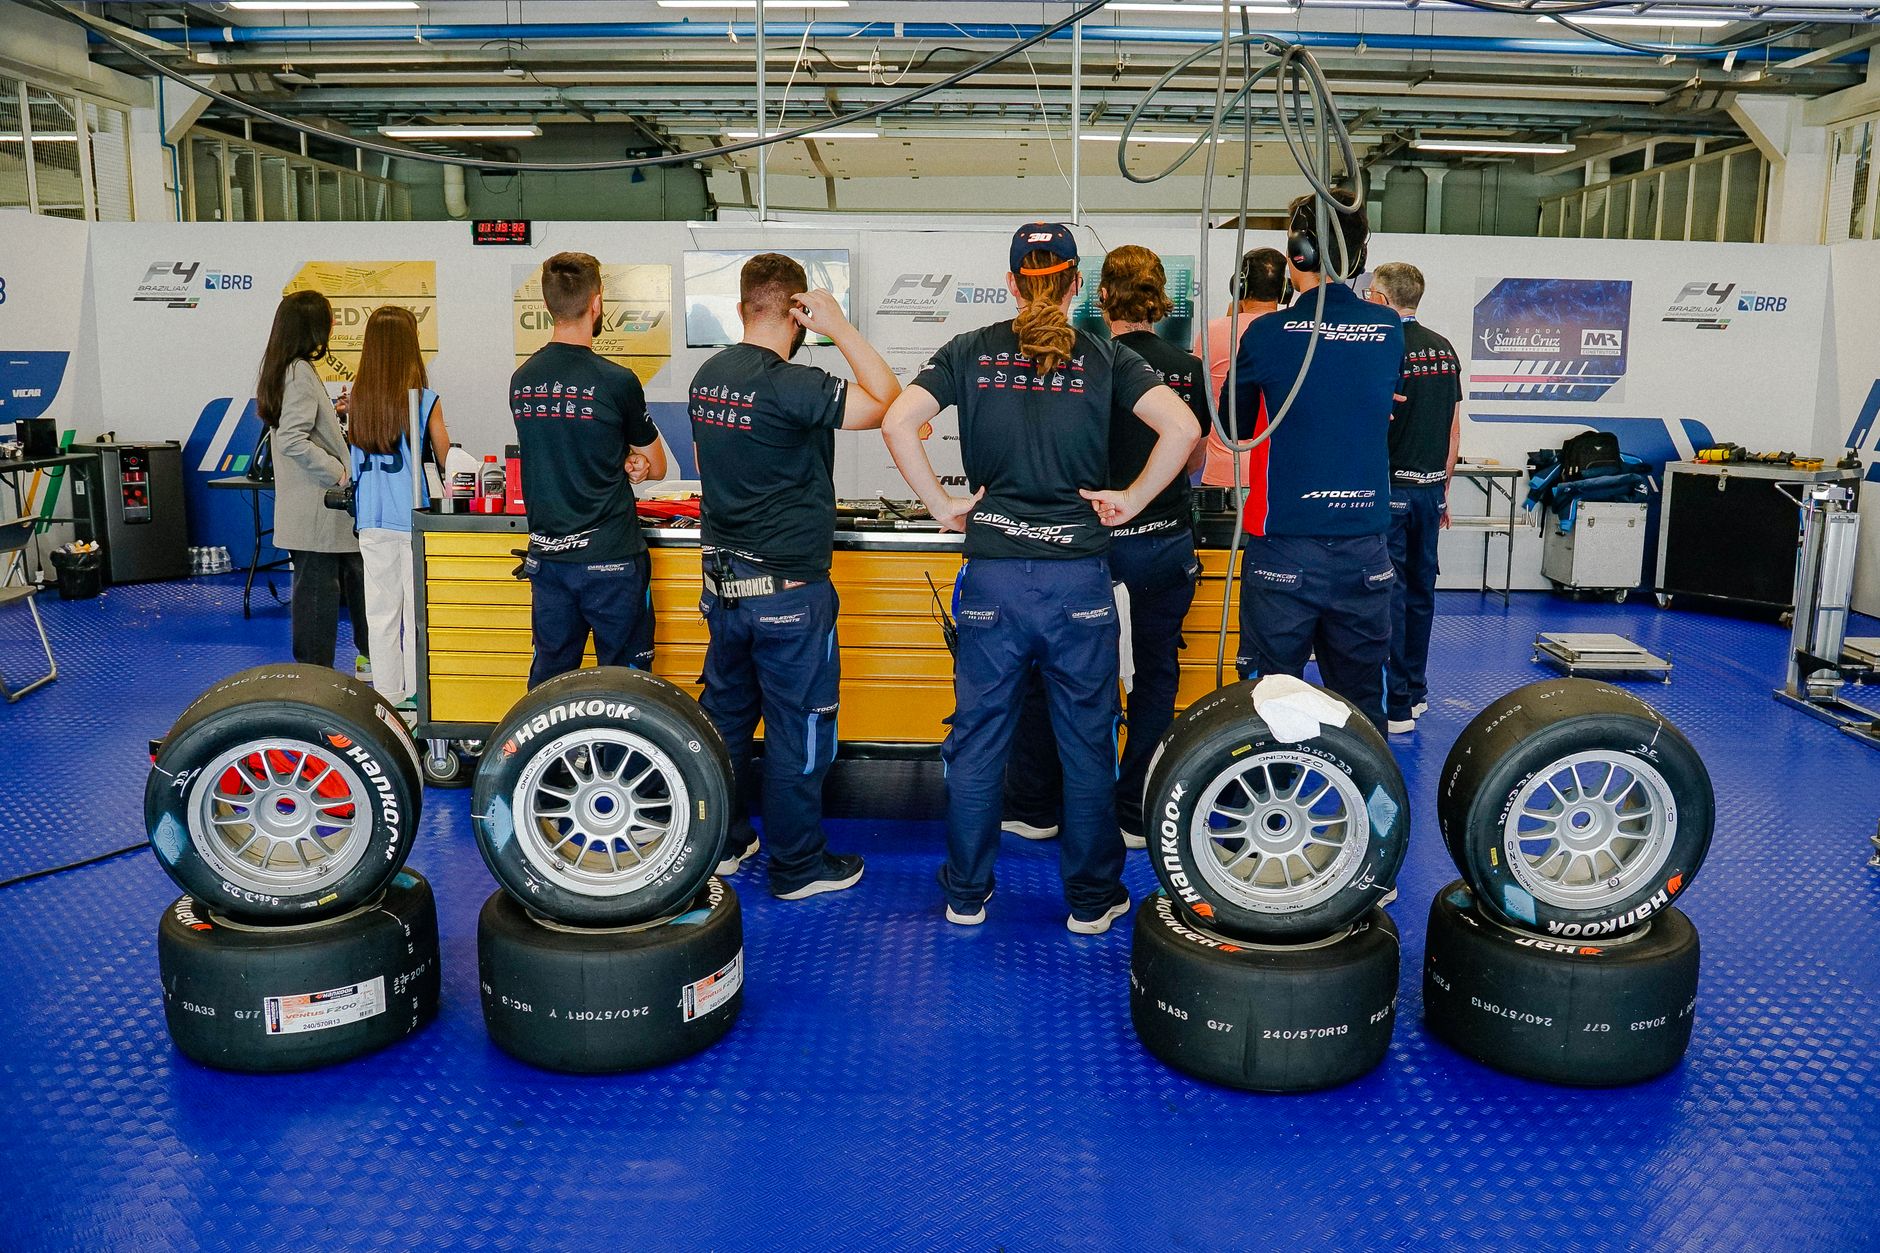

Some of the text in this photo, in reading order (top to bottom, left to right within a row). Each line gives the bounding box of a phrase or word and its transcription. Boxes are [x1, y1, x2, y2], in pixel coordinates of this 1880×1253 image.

[141, 261, 201, 284] F4
[221, 274, 253, 290] BRB
[887, 273, 953, 297] F4
[973, 287, 1008, 304] BRB
[1673, 281, 1737, 305] F4
[1668, 305, 1722, 313] BRAZILIAN
[1754, 296, 1788, 312] BRB
[615, 310, 666, 329] F4
[1324, 331, 1387, 342] SPORTS
[1494, 333, 1560, 347] Santa Cruz
[1583, 332, 1620, 347] MR
[1394, 469, 1446, 479] CAVALEIRO
[1004, 526, 1074, 544] SPORTS
[541, 538, 590, 552] SPORTS
[720, 575, 775, 598] LECTRONICS
[1539, 688, 1565, 699] G77
[1485, 704, 1522, 734] 23A33
[1258, 754, 1298, 762] RACING
[1513, 862, 1535, 892] RACING
[182, 1000, 261, 1020] 20A33 G77
[326, 1002, 358, 1014] F200
[564, 1005, 650, 1021] 240/570R1
[1471, 996, 1553, 1028] 240/570R13
[1583, 1023, 1611, 1033] G77
[1630, 1015, 1666, 1031] 20A33
[302, 1018, 341, 1030] 240/570R13
[1206, 1018, 1234, 1033] G77
[1262, 1024, 1349, 1040] 240/570R13
